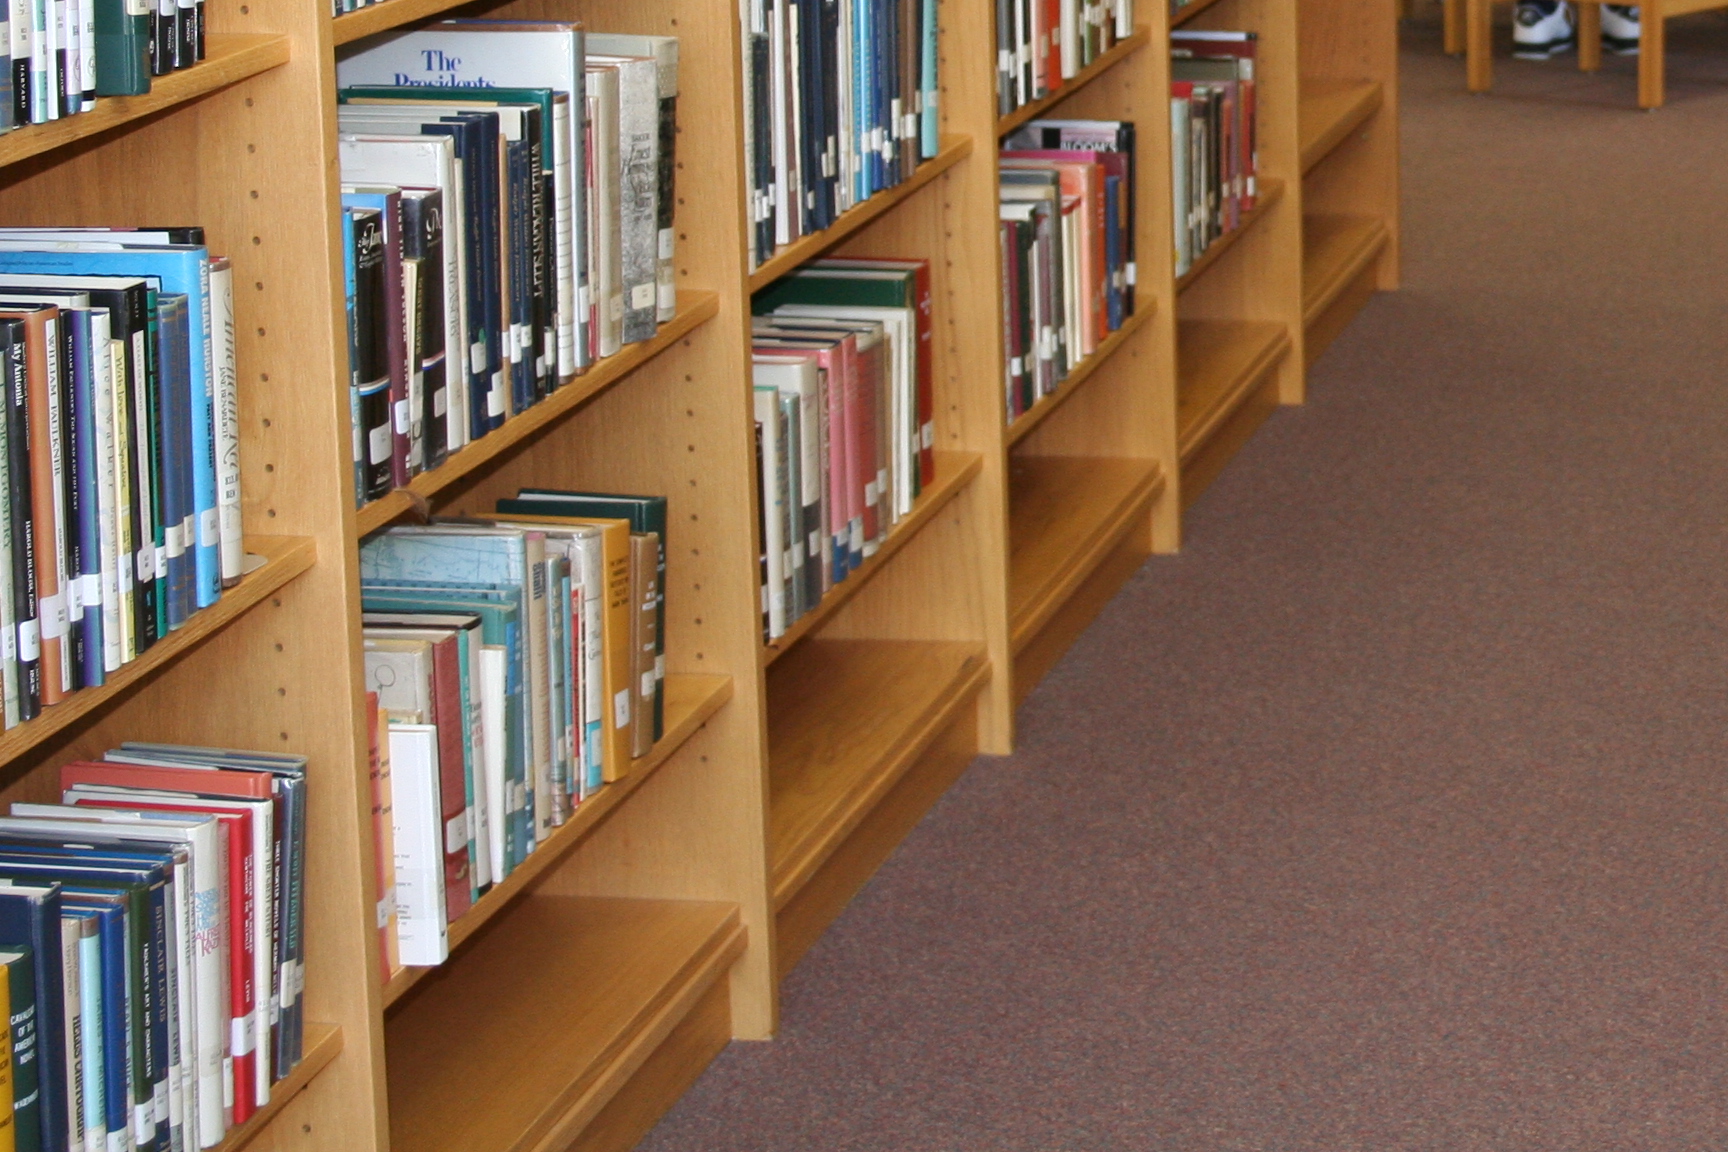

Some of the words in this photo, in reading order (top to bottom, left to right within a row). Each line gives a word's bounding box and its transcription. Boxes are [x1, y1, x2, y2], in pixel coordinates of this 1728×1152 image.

[421, 49, 461, 72] The
[201, 297, 210, 336] NEALE
[47, 333, 56, 397] WILLIAM
[202, 338, 213, 398] HURSTON
[51, 404, 61, 478] FAULKNER
[157, 978, 167, 1023] LEWIS
